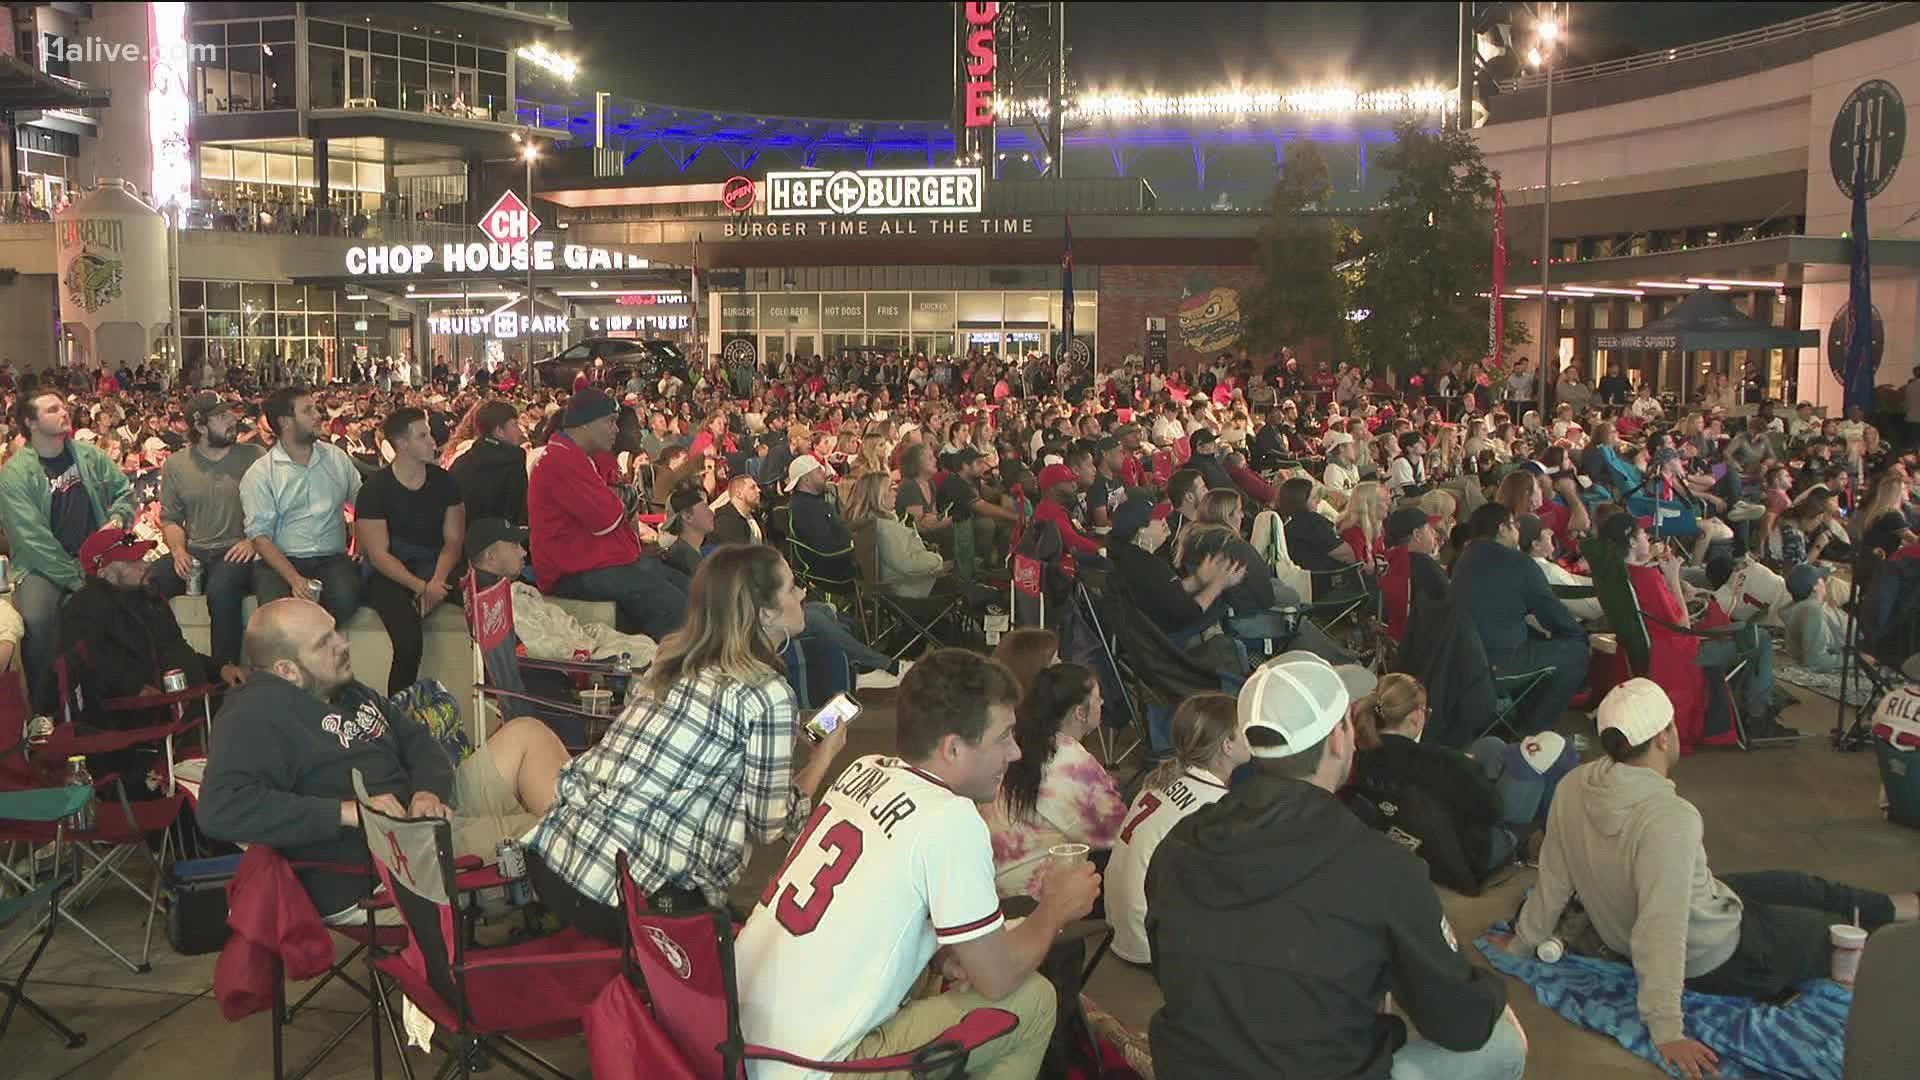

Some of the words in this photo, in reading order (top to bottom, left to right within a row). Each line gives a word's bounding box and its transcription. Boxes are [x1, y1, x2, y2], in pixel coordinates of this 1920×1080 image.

[725, 183, 754, 203] OPEN
[774, 178, 825, 209] H&F
[867, 175, 974, 207] BURGER
[490, 209, 529, 240] CH
[724, 221, 807, 237] BURGER
[819, 220, 868, 235] TIME
[880, 219, 918, 234] ALL
[930, 219, 969, 234] THE
[981, 218, 1033, 233] TIME
[345, 243, 434, 275] CHOP
[443, 240, 555, 273] HOUSE
[427, 316, 491, 335] TRUIST
[824, 306, 840, 316] HOT
[841, 306, 862, 316] DOGS
[877, 306, 899, 316] FRIES
[1162, 781, 1197, 811] SON
[869, 791, 918, 840] JR.
[1119, 791, 1162, 845] 7
[760, 801, 865, 938] 13
